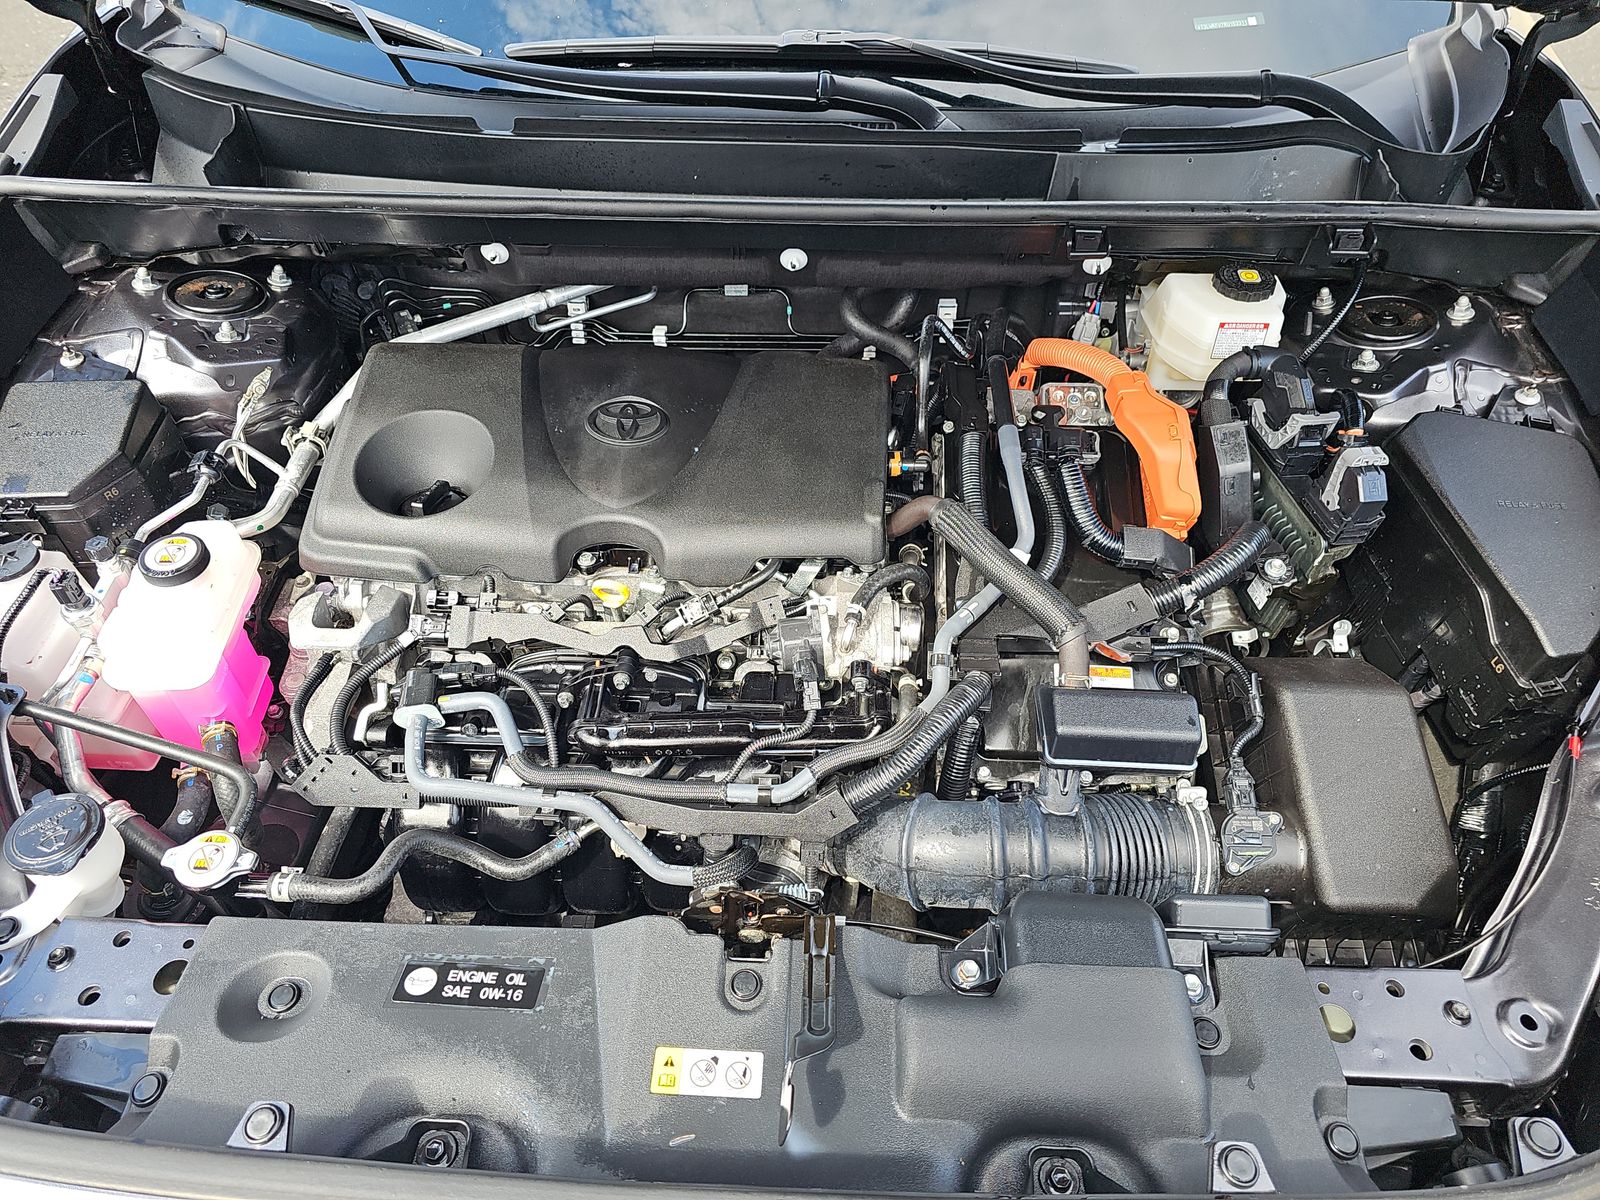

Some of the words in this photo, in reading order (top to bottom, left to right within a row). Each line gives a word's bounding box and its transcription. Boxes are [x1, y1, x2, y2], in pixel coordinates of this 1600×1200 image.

[103, 486, 119, 501] R6
[1496, 499, 1529, 509] RELAY
[1490, 655, 1505, 674] L6
[446, 969, 499, 984] ENGINE
[505, 973, 527, 986] OIL
[441, 985, 472, 998] SAE
[479, 986, 523, 1001] 0W-16
